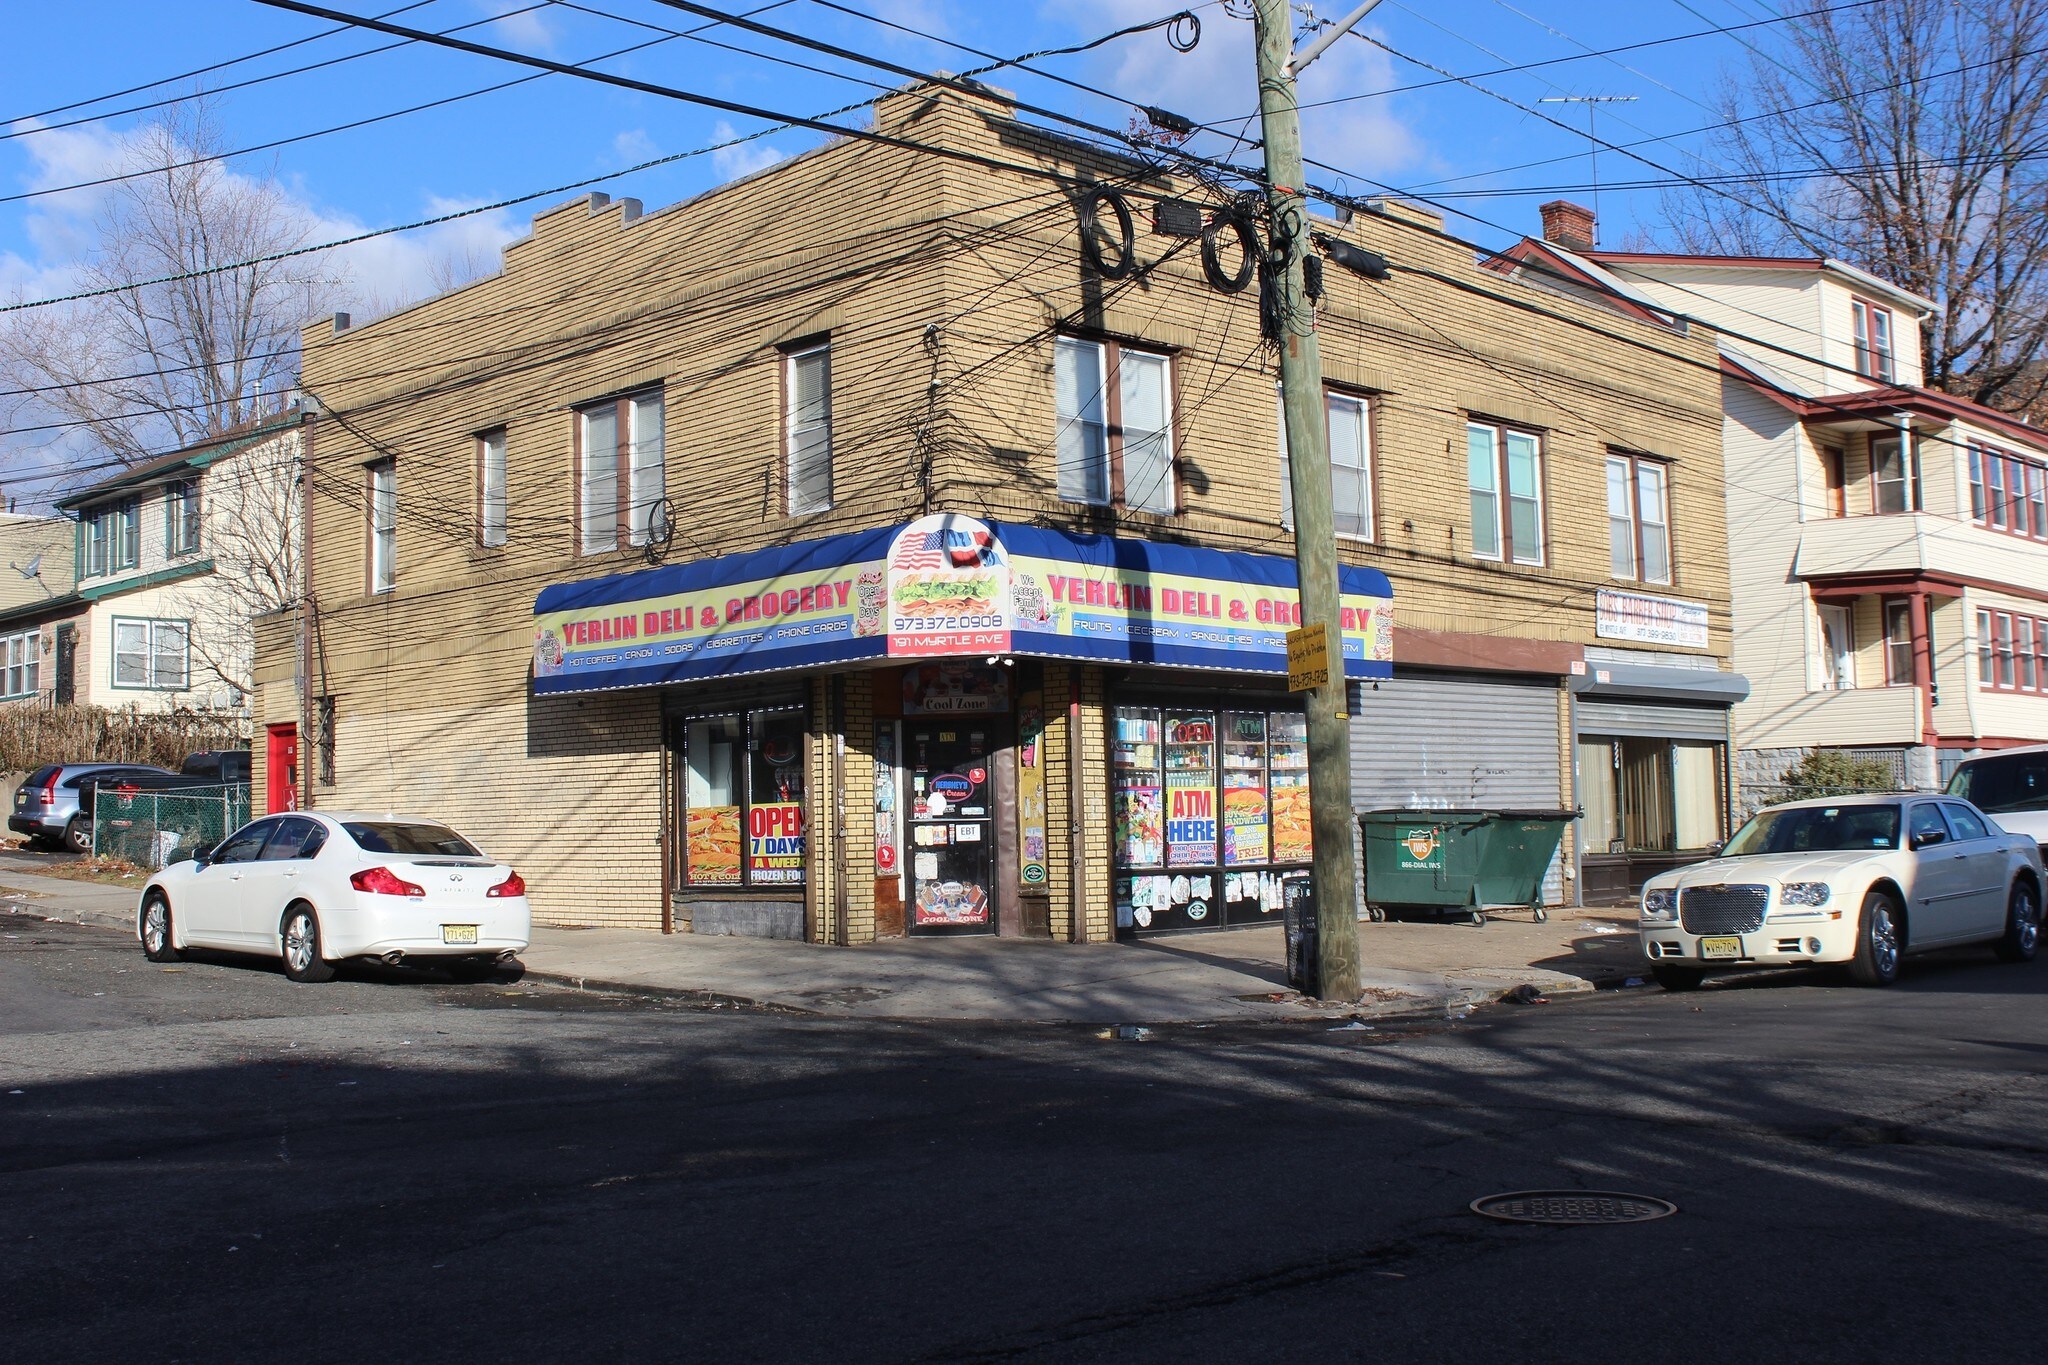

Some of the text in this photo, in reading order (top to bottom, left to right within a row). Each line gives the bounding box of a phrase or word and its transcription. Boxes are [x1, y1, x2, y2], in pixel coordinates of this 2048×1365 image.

[1019, 573, 1035, 586] We
[858, 585, 880, 598] Open
[1012, 584, 1043, 598] Accept
[1046, 574, 1372, 632] YERLIN DELI & GRORY
[562, 579, 853, 647] YERLIN DELI & GROCERY
[859, 606, 880, 619] Days
[894, 614, 1003, 631] 973.372.0908
[893, 633, 1004, 647] 191 MYRTLE AVE
[1073, 620, 1112, 633] FRUITS
[1190, 630, 1253, 646] SANDWICHES
[569, 620, 848, 667] HOT COFFEE CANDY SODAS CIGARETTES PHONE CARDS
[925, 697, 986, 711] Cool Zone
[1177, 723, 1213, 743] OPEN
[1235, 719, 1261, 734] ATM
[1172, 790, 1212, 818] ATM
[750, 806, 805, 838] OPEN
[961, 826, 976, 836] EBT
[1169, 820, 1216, 842] HERE
[751, 837, 806, 855] 7 DAYS
[1238, 846, 1264, 858] FREE
[1413, 842, 1428, 853] IWS
[755, 858, 765, 868] A
[750, 870, 784, 881] FROZEN
